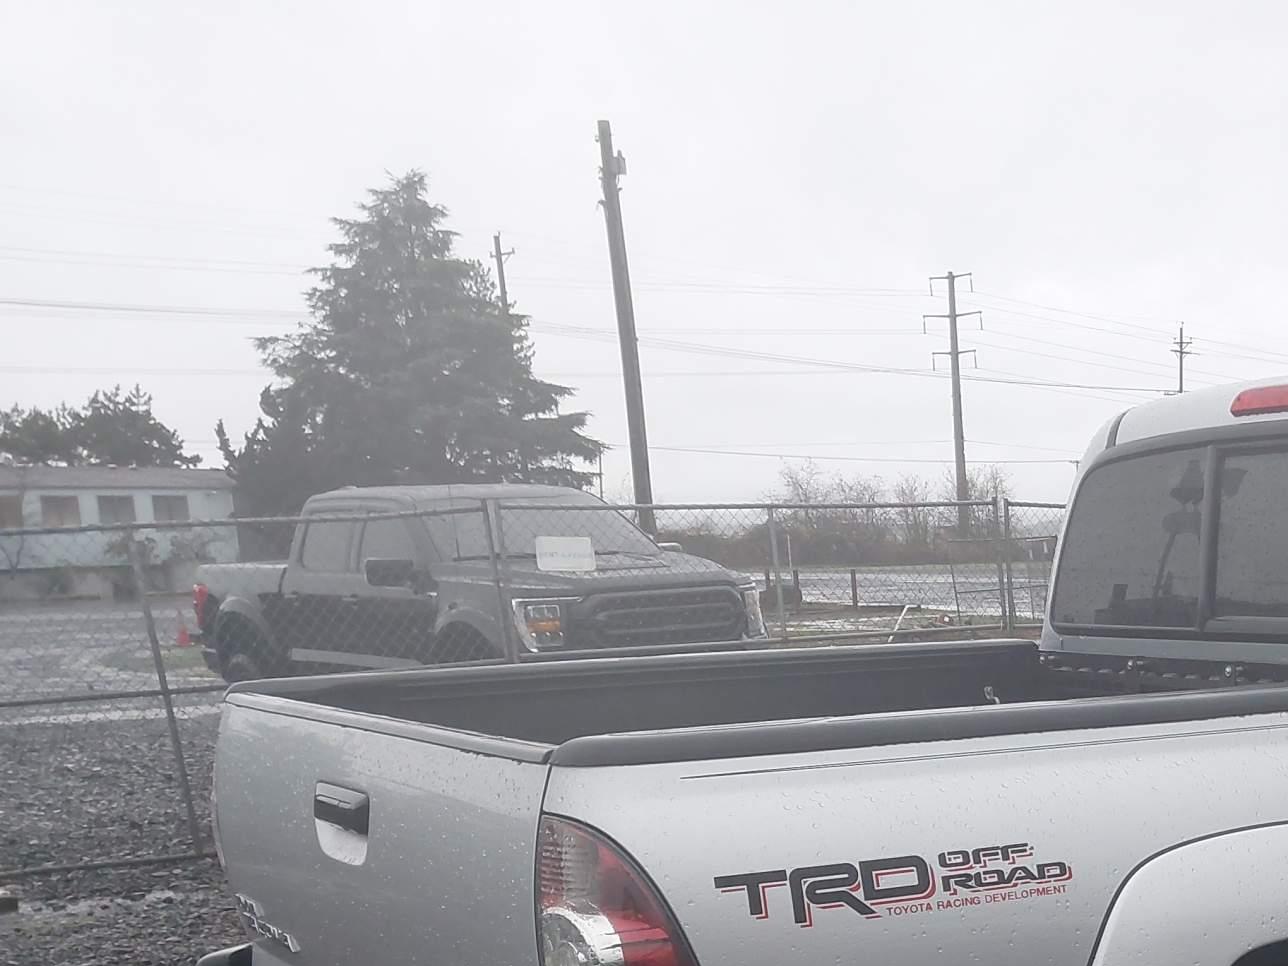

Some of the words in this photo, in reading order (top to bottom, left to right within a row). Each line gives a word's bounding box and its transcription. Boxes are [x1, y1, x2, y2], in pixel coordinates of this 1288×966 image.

[937, 842, 1034, 872] OFF
[713, 855, 934, 928] TRD
[940, 861, 1073, 896] ROAD
[886, 902, 933, 917] TOYOTA
[937, 896, 981, 911] RACING
[985, 884, 1068, 904] DEVELOPMENT
